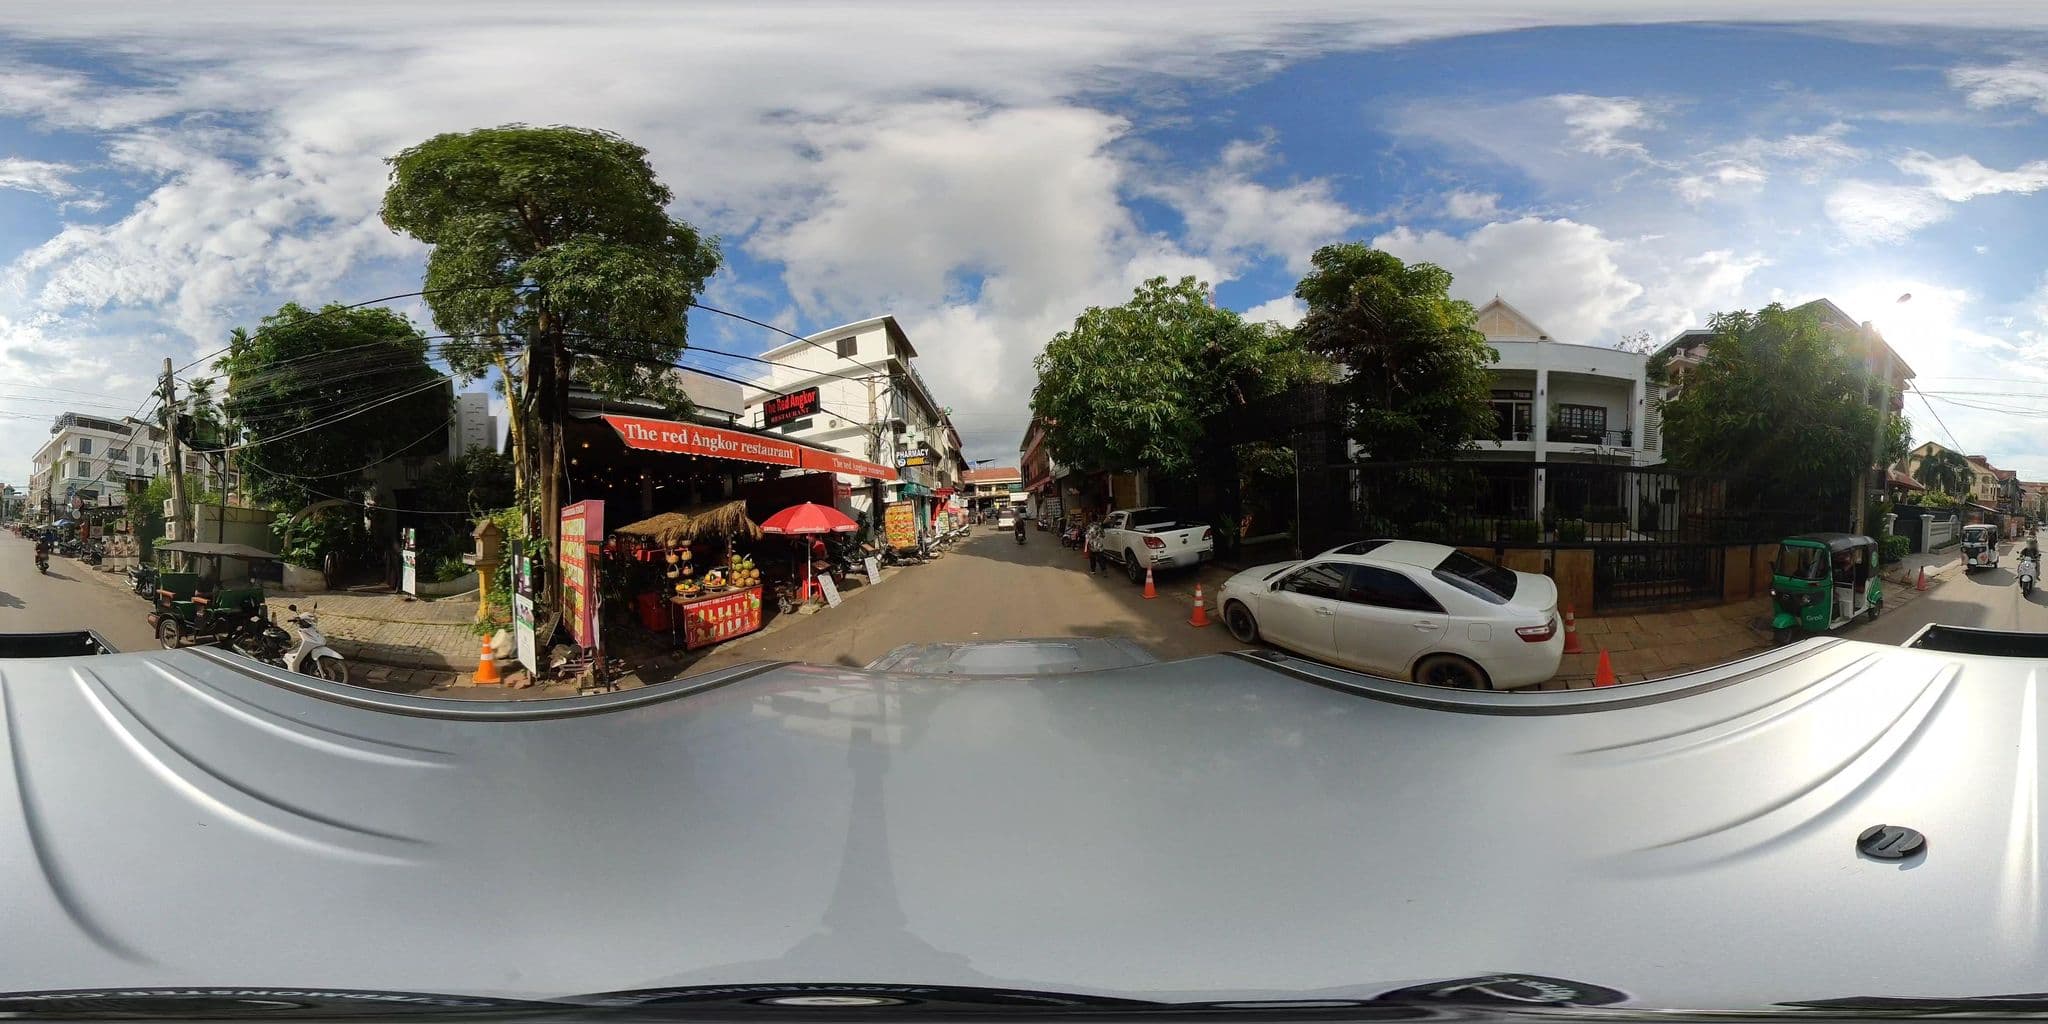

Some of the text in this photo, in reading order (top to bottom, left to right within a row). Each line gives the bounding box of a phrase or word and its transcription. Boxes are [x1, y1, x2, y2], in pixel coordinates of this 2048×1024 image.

[776, 396, 790, 410] Red
[790, 390, 816, 409] Angkor
[771, 407, 809, 422] RESTAURANT
[624, 423, 793, 459] The red Angkor restaurant
[896, 448, 929, 458] PHARMACY
